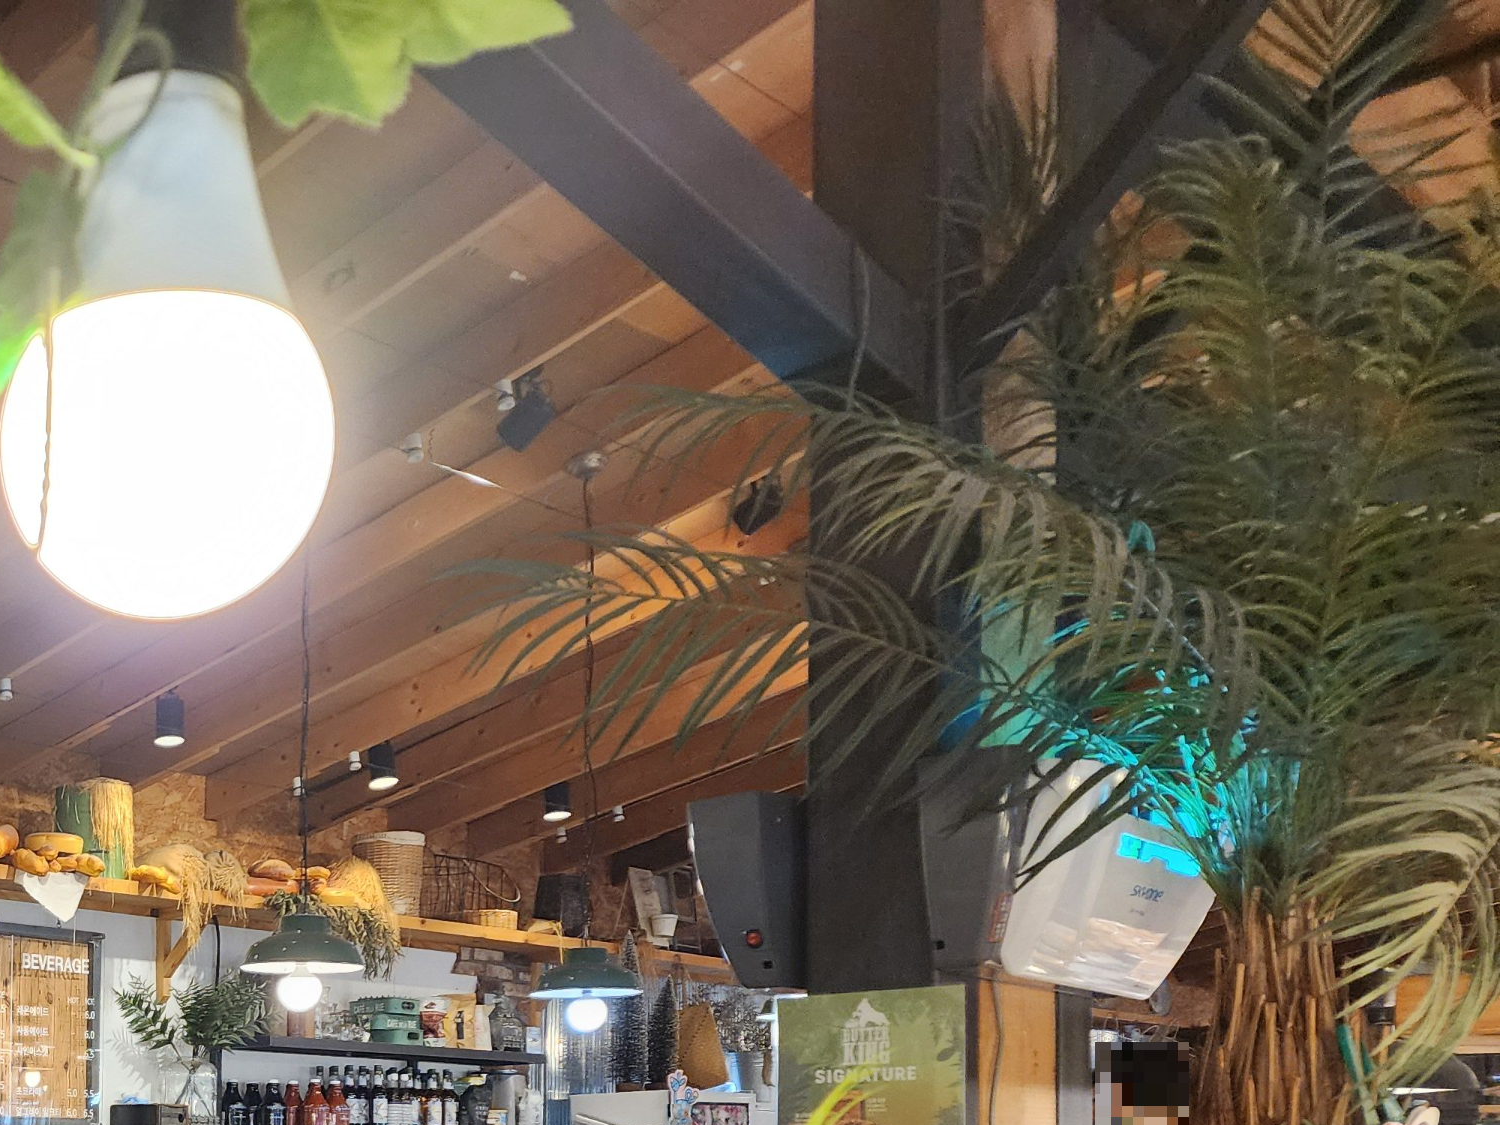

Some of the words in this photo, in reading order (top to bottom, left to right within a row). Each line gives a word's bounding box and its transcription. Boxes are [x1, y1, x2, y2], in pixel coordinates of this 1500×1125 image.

[22, 953, 89, 974] BEVERAGE
[842, 1027, 889, 1041] BUTTER
[842, 1042, 890, 1066] KING
[66, 1109, 77, 1117] 6.0
[83, 1109, 94, 1118] 6.5
